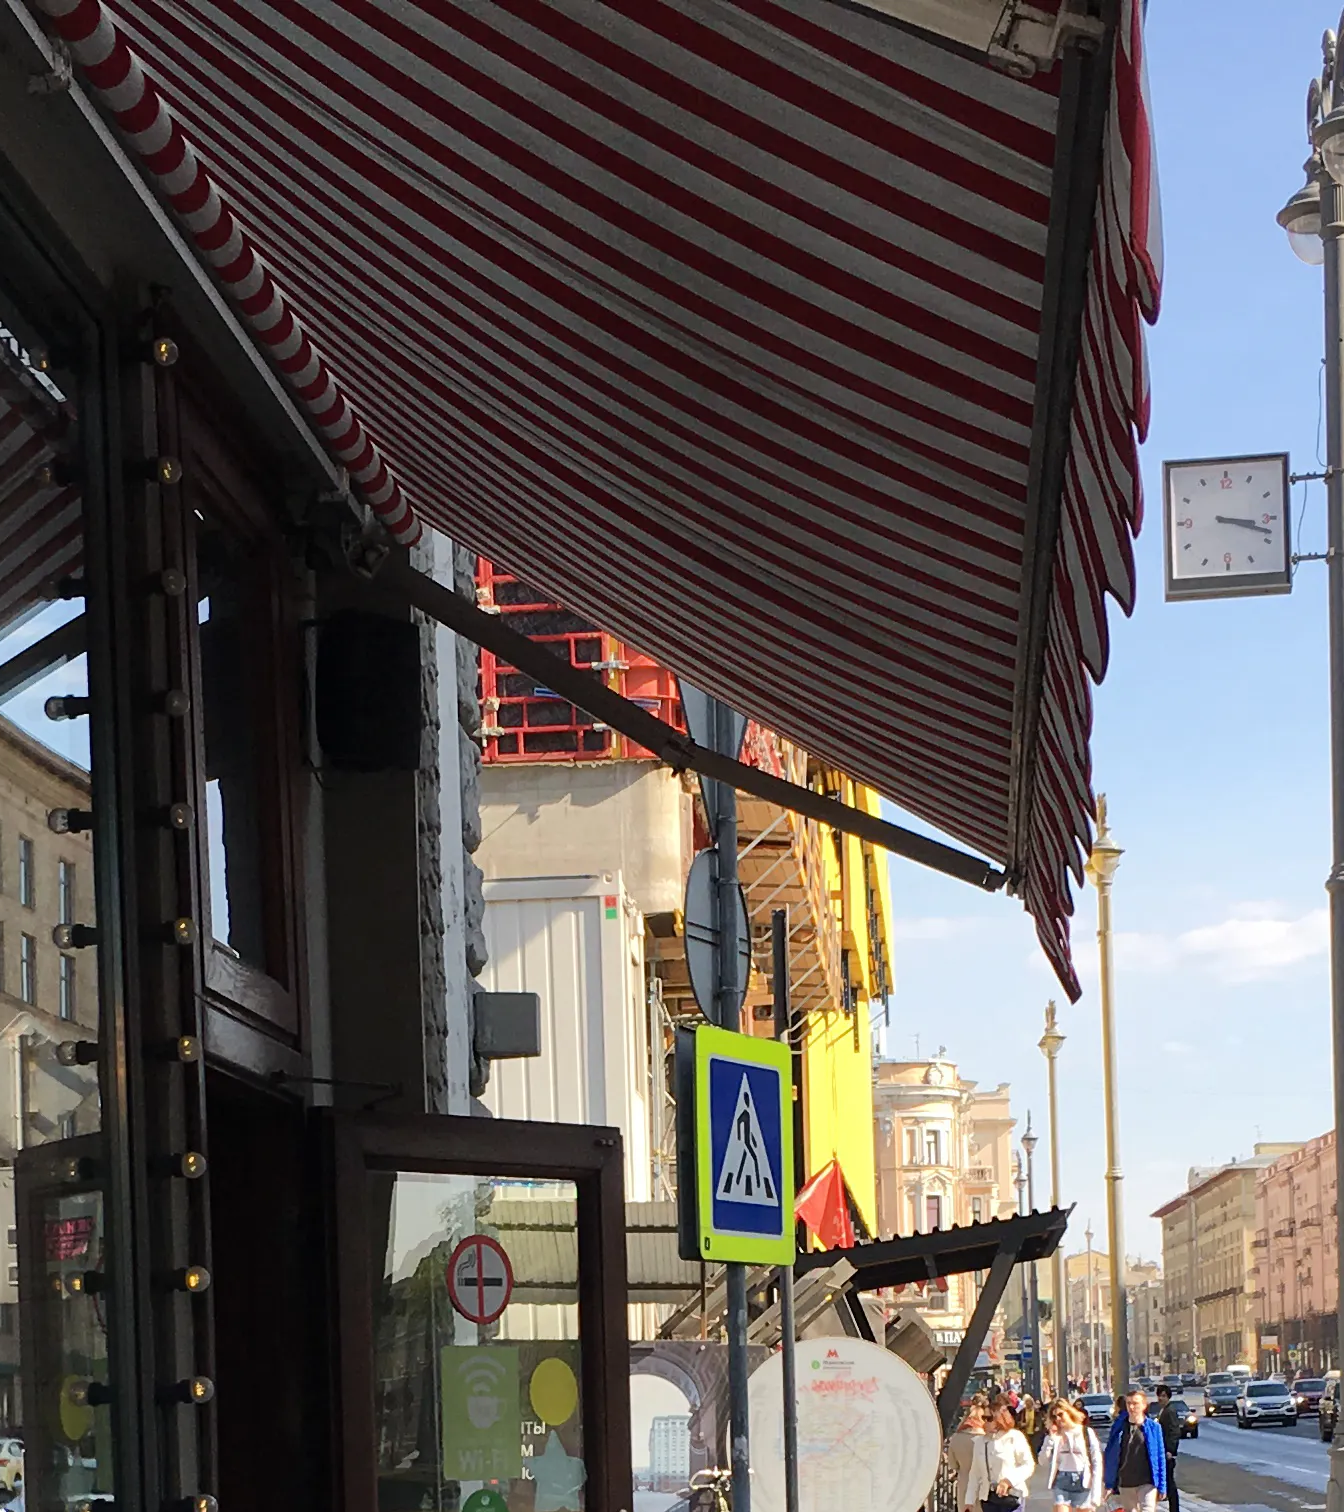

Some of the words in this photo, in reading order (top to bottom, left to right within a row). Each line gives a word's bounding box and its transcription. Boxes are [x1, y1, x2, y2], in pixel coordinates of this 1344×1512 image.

[1220, 478, 1232, 489] 12
[1262, 513, 1271, 524] 3
[1223, 552, 1232, 563] 6
